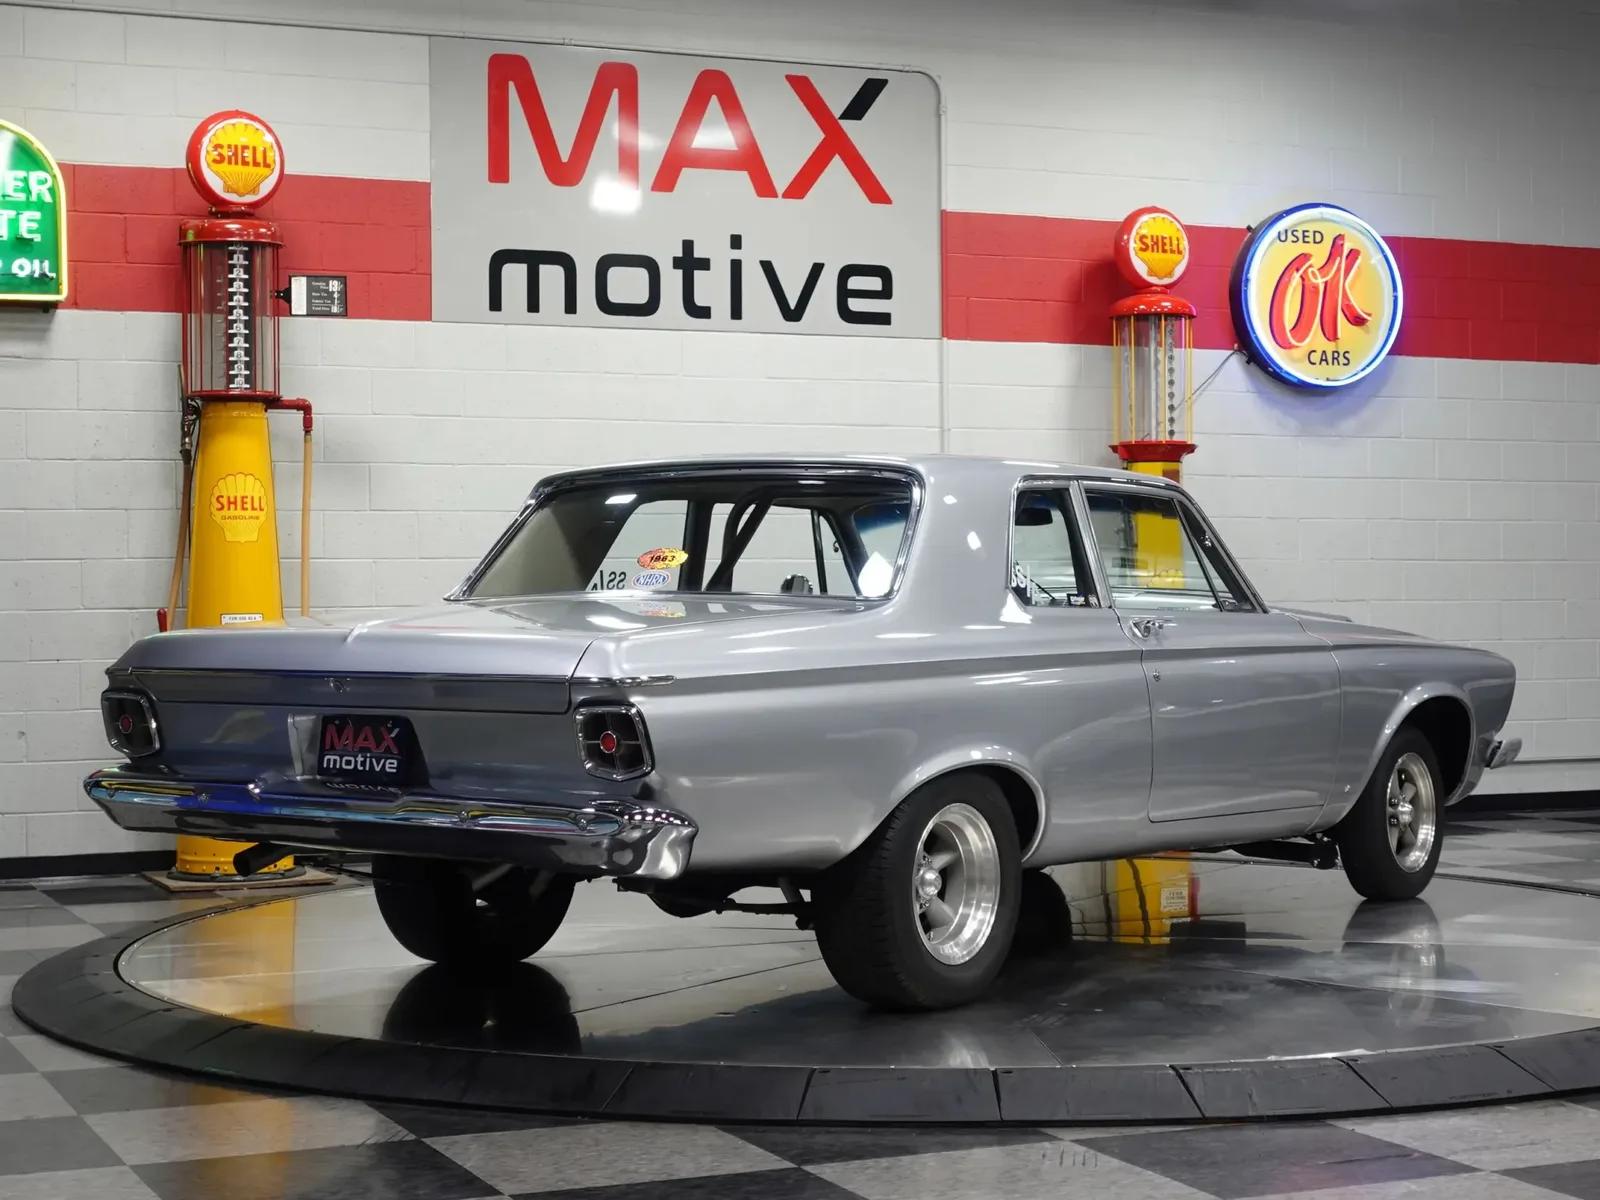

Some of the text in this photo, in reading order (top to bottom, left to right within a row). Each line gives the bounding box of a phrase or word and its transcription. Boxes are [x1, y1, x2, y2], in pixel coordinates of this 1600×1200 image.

[488, 53, 893, 205] MAX
[212, 143, 271, 169] SHELL
[1138, 234, 1183, 255] SHELL
[1277, 229, 1324, 244] USED
[11, 257, 56, 279] OIL
[488, 234, 893, 326] motive
[1307, 349, 1350, 366] CARS
[216, 495, 264, 511] SHELL
[324, 723, 400, 754] MAX
[323, 753, 398, 773] motive
